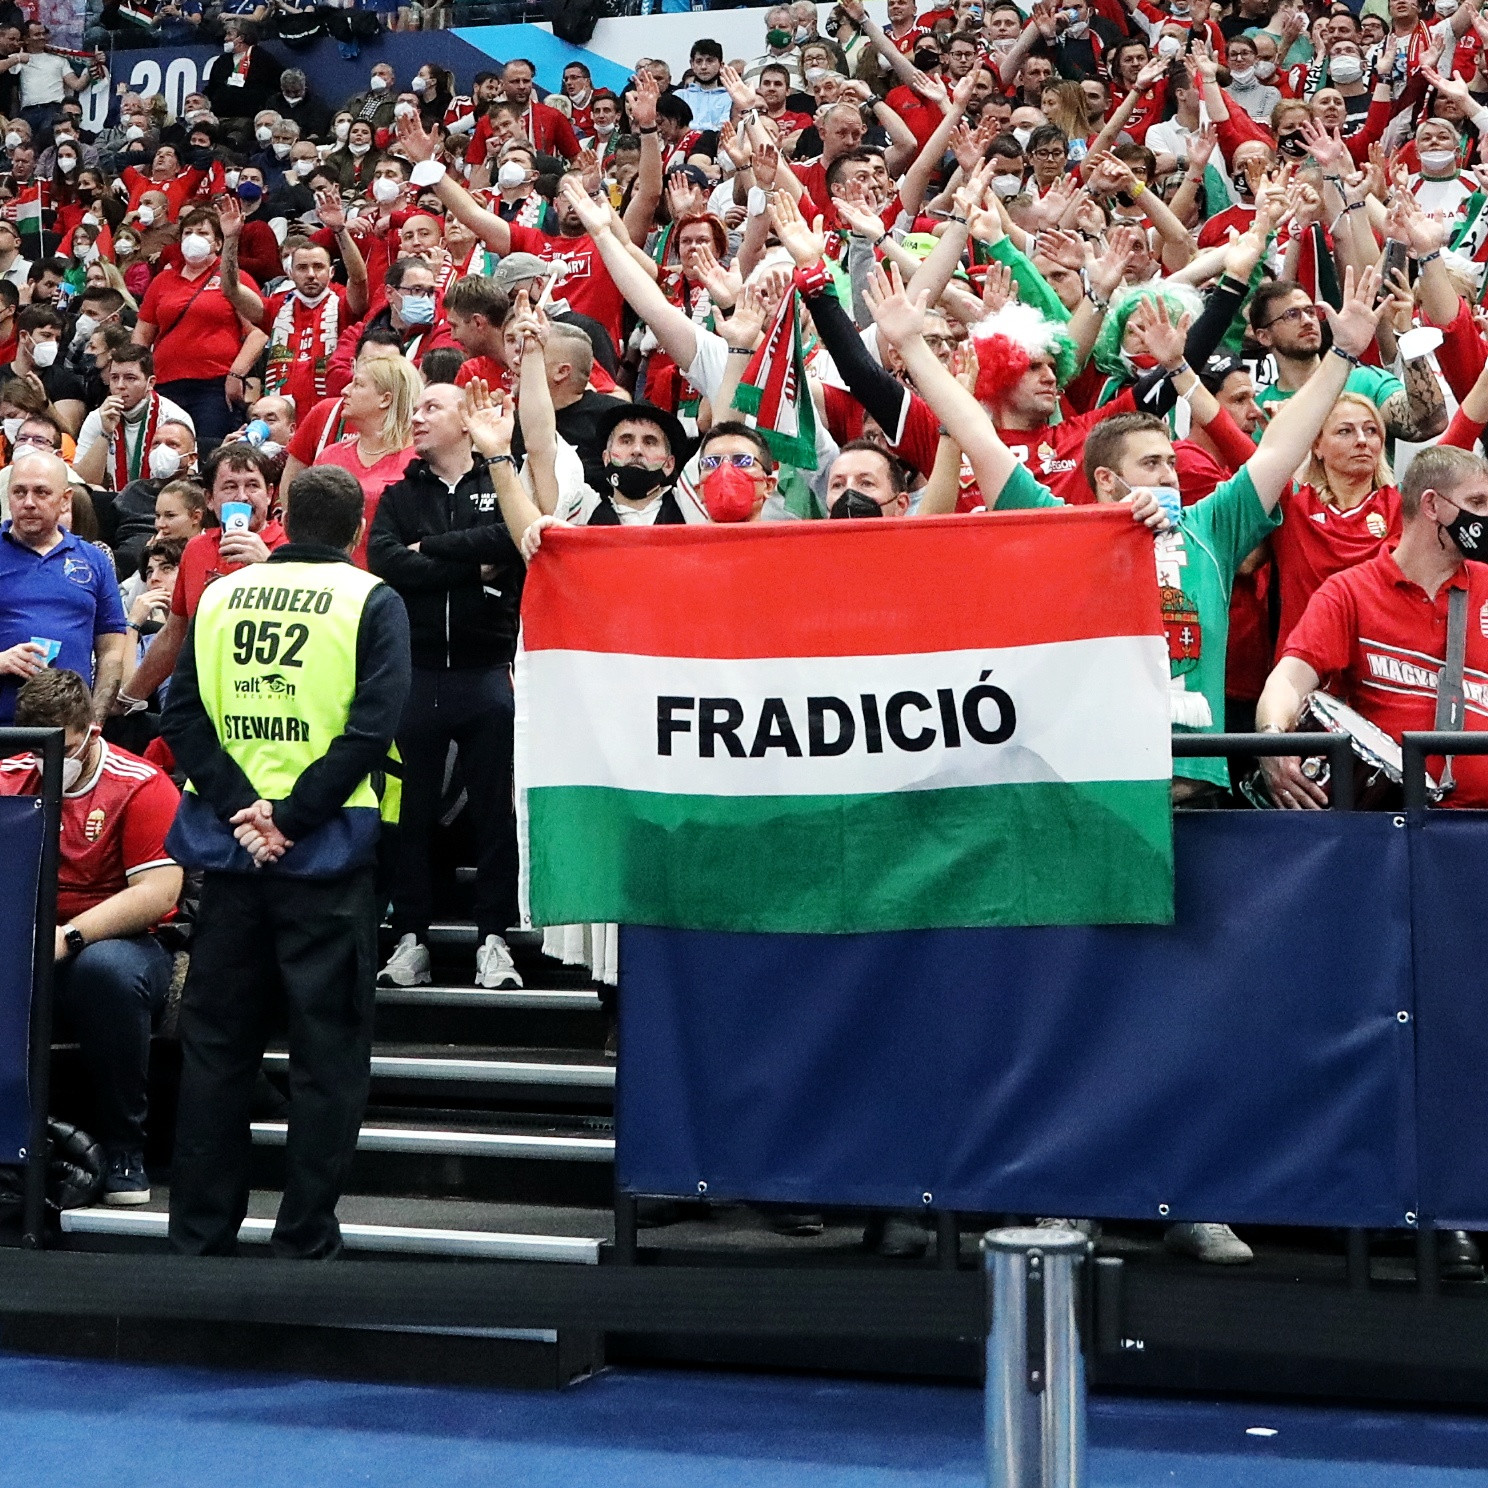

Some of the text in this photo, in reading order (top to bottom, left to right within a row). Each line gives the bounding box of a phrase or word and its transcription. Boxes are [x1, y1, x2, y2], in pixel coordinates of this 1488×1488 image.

[228, 587, 335, 615] RENDEZŐ
[233, 619, 310, 668] 952
[225, 714, 310, 742] STEWARD
[657, 668, 1017, 759] FRADICIÓ
